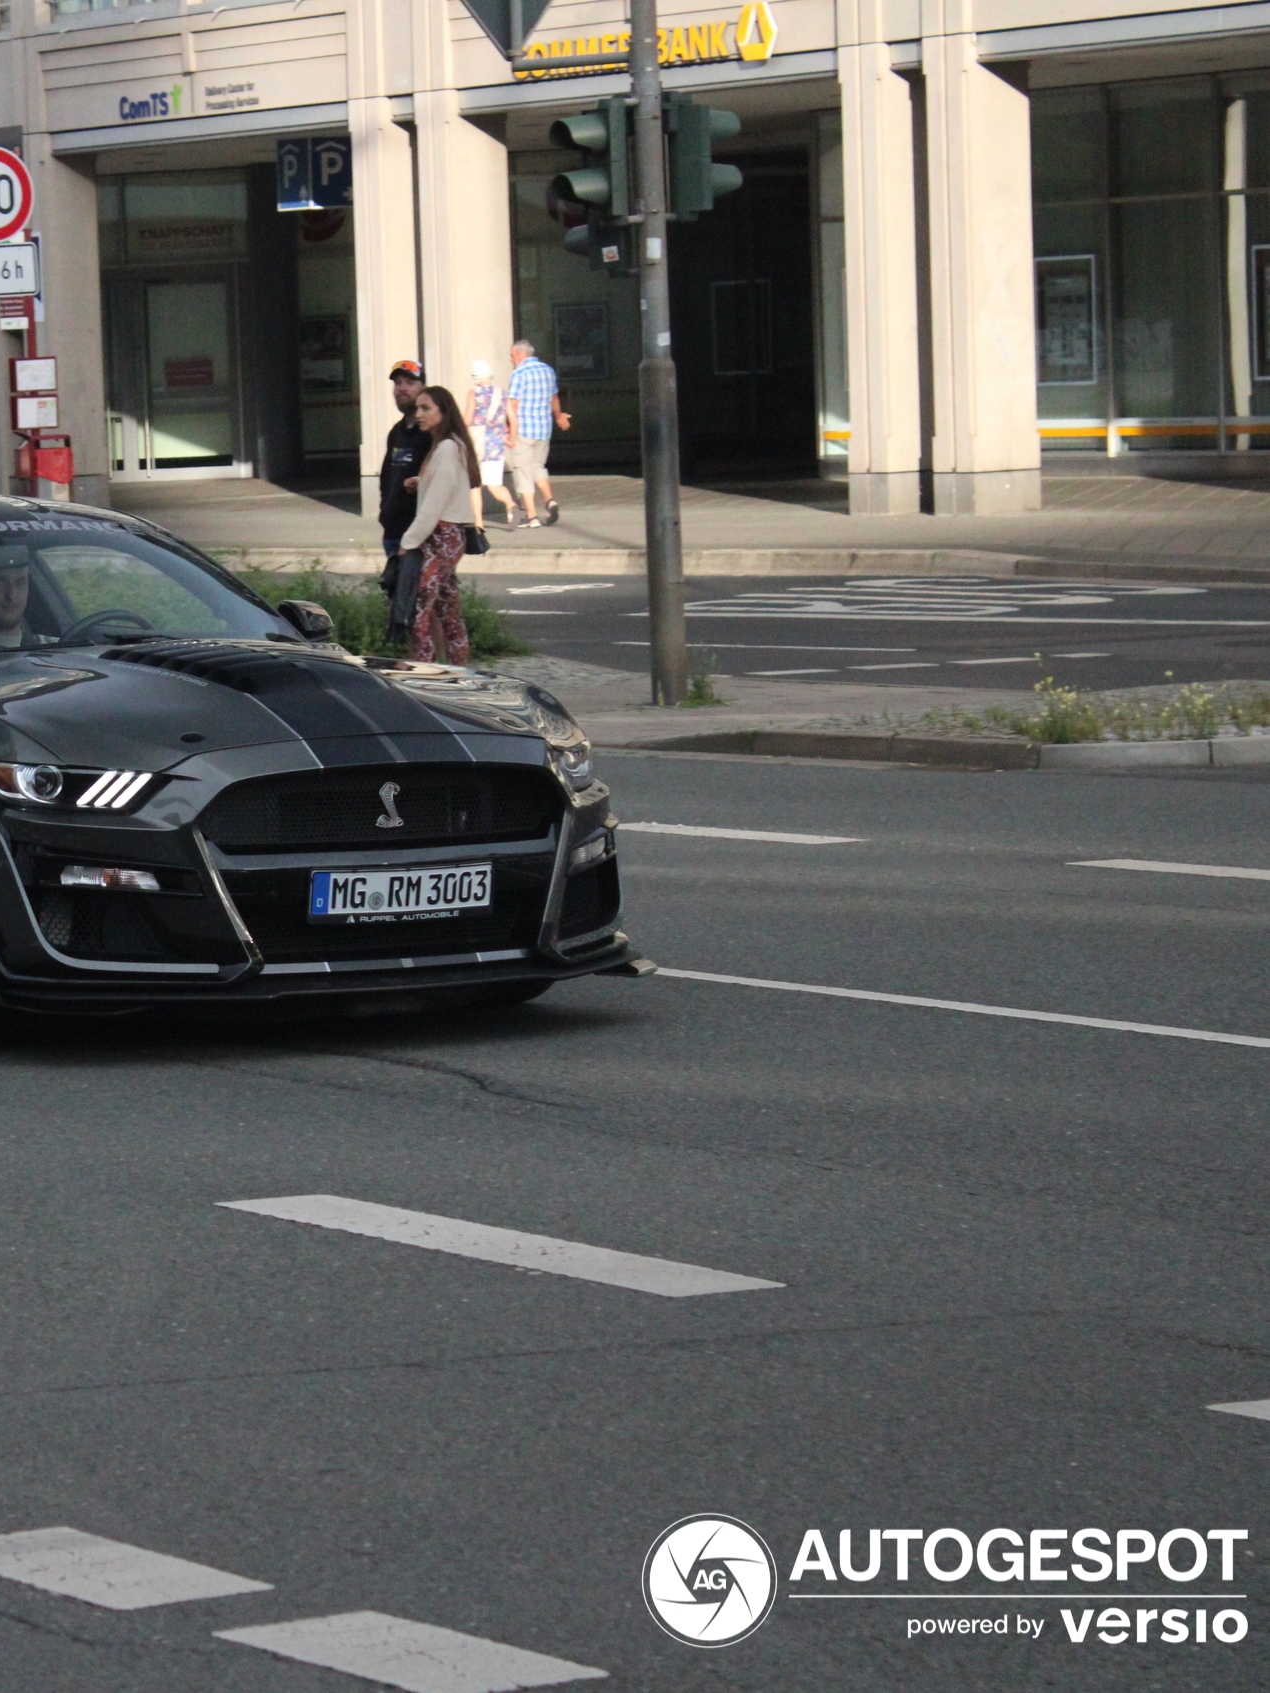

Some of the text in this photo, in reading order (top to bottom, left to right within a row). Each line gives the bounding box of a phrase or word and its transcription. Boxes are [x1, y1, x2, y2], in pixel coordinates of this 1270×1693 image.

[514, 20, 729, 79] OMMEBANK
[120, 92, 170, 120] ComTS
[284, 154, 297, 188] P
[321, 152, 343, 186] P
[15, 260, 23, 279] h
[176, 675, 209, 688] FORD
[316, 897, 323, 907] D
[331, 870, 487, 909] MG RM 3003
[401, 910, 460, 921] AUTOMOBILE
